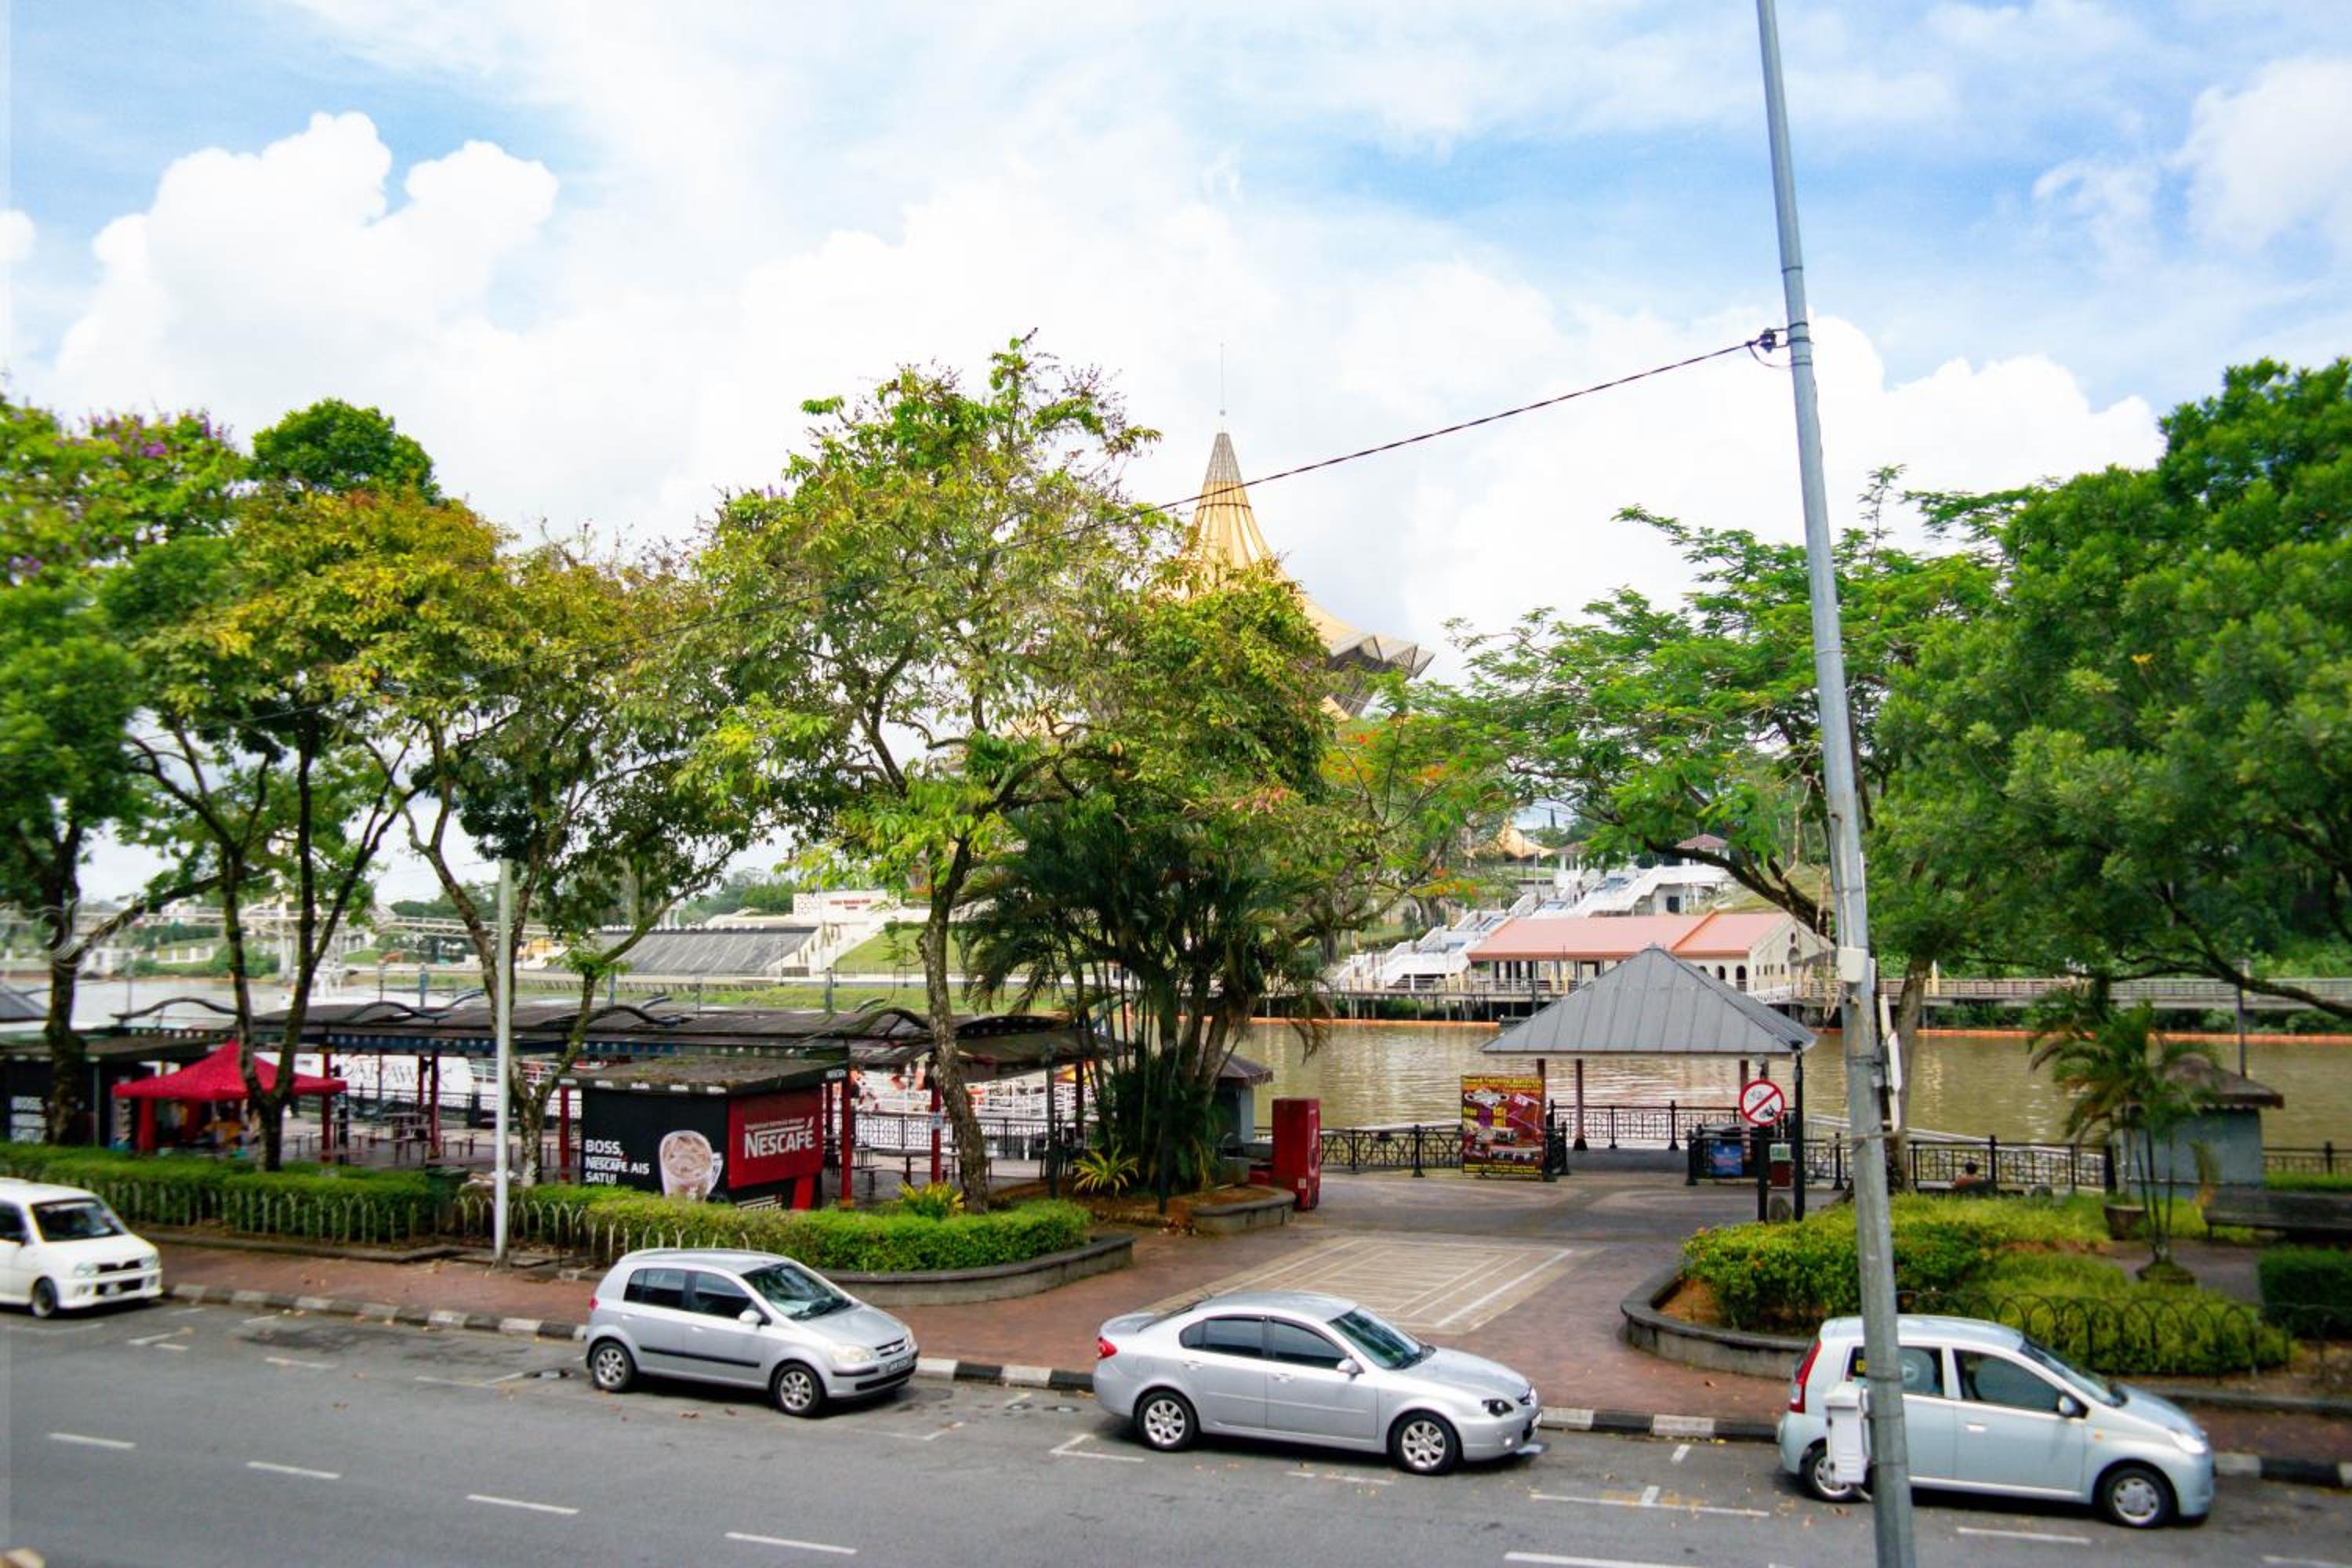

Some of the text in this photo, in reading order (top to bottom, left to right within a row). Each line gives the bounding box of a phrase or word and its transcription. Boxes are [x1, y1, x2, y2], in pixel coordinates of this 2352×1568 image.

[744, 1116, 816, 1159] NESCAFÉ
[585, 1139, 624, 1156] BOSS,
[630, 1162, 650, 1175] AIS
